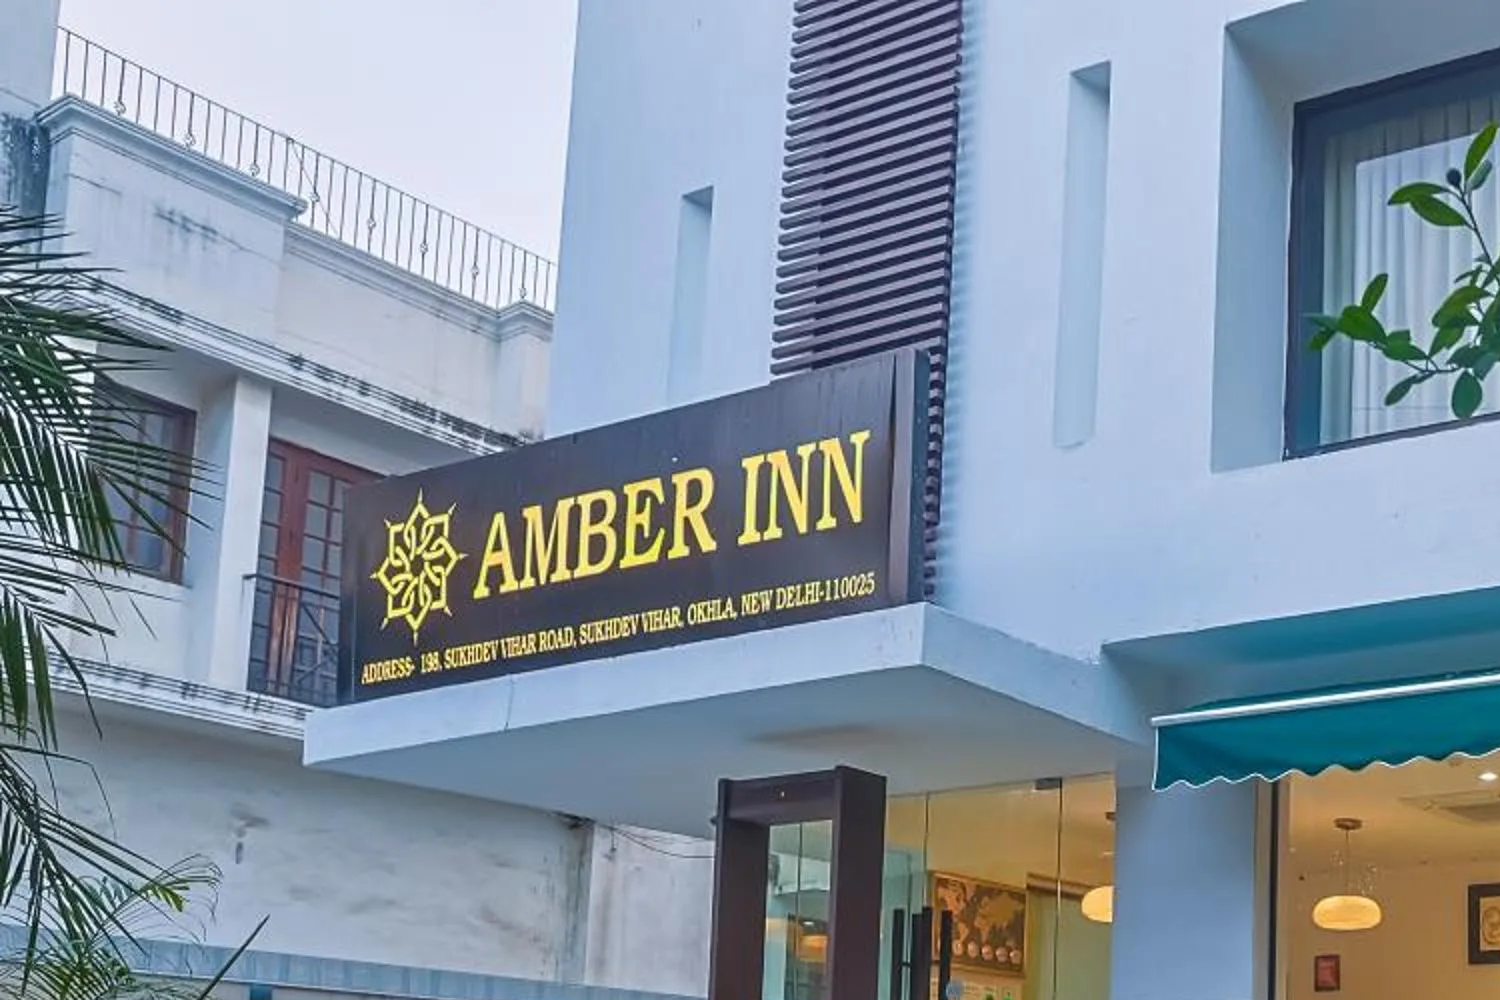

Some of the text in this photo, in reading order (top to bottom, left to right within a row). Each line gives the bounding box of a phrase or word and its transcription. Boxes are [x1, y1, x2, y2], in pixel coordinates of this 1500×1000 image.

[473, 430, 871, 600] AMBER INN
[444, 639, 499, 669] SUKHDEV
[501, 633, 537, 659] VIHAR
[579, 612, 639, 645] SUKHDEV
[741, 588, 774, 616] NEW
[775, 571, 876, 610] DELHI-110025
